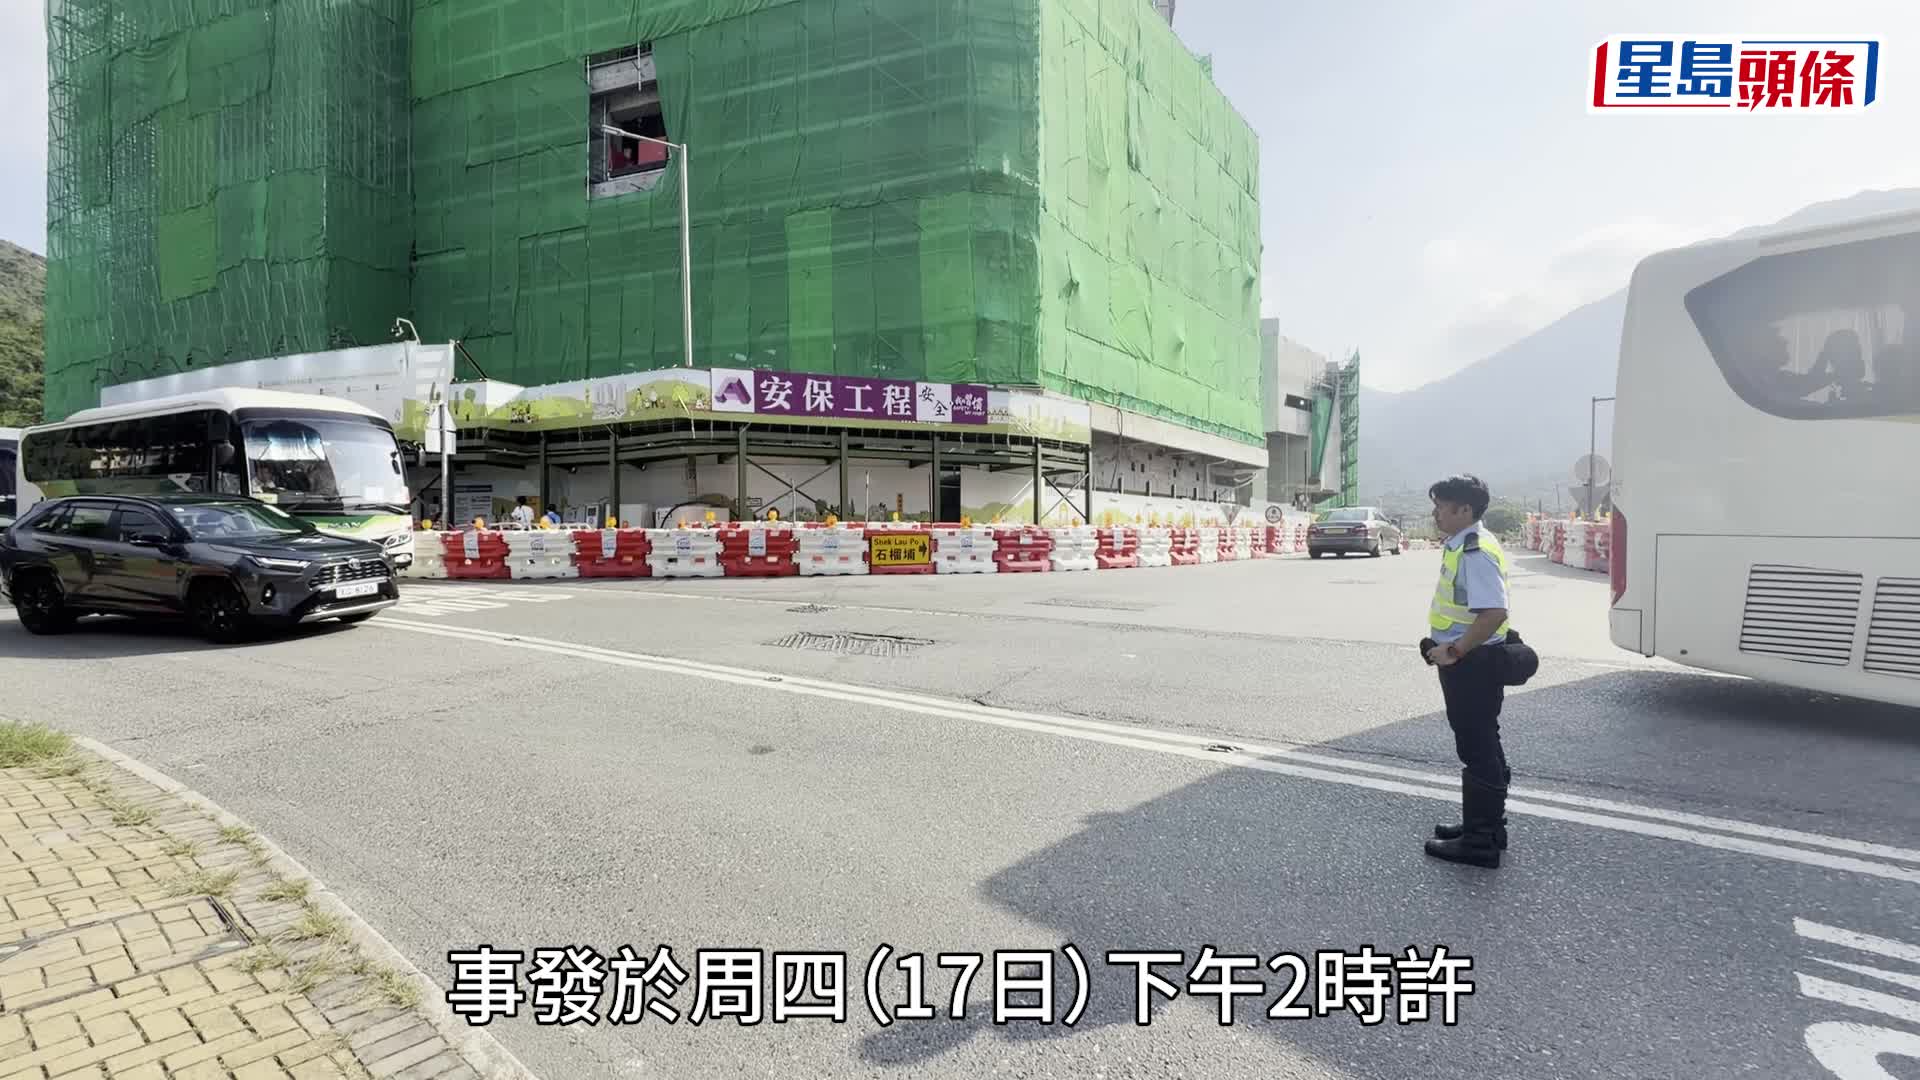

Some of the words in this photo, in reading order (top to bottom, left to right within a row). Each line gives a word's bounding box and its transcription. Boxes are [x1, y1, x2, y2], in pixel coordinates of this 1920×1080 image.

[760, 376, 912, 416] 安保工程
[918, 385, 949, 417] 安全
[873, 538, 891, 546] Shek
[894, 538, 908, 546] Lau
[910, 538, 919, 546] Po
[874, 548, 916, 561] 石榴埔
